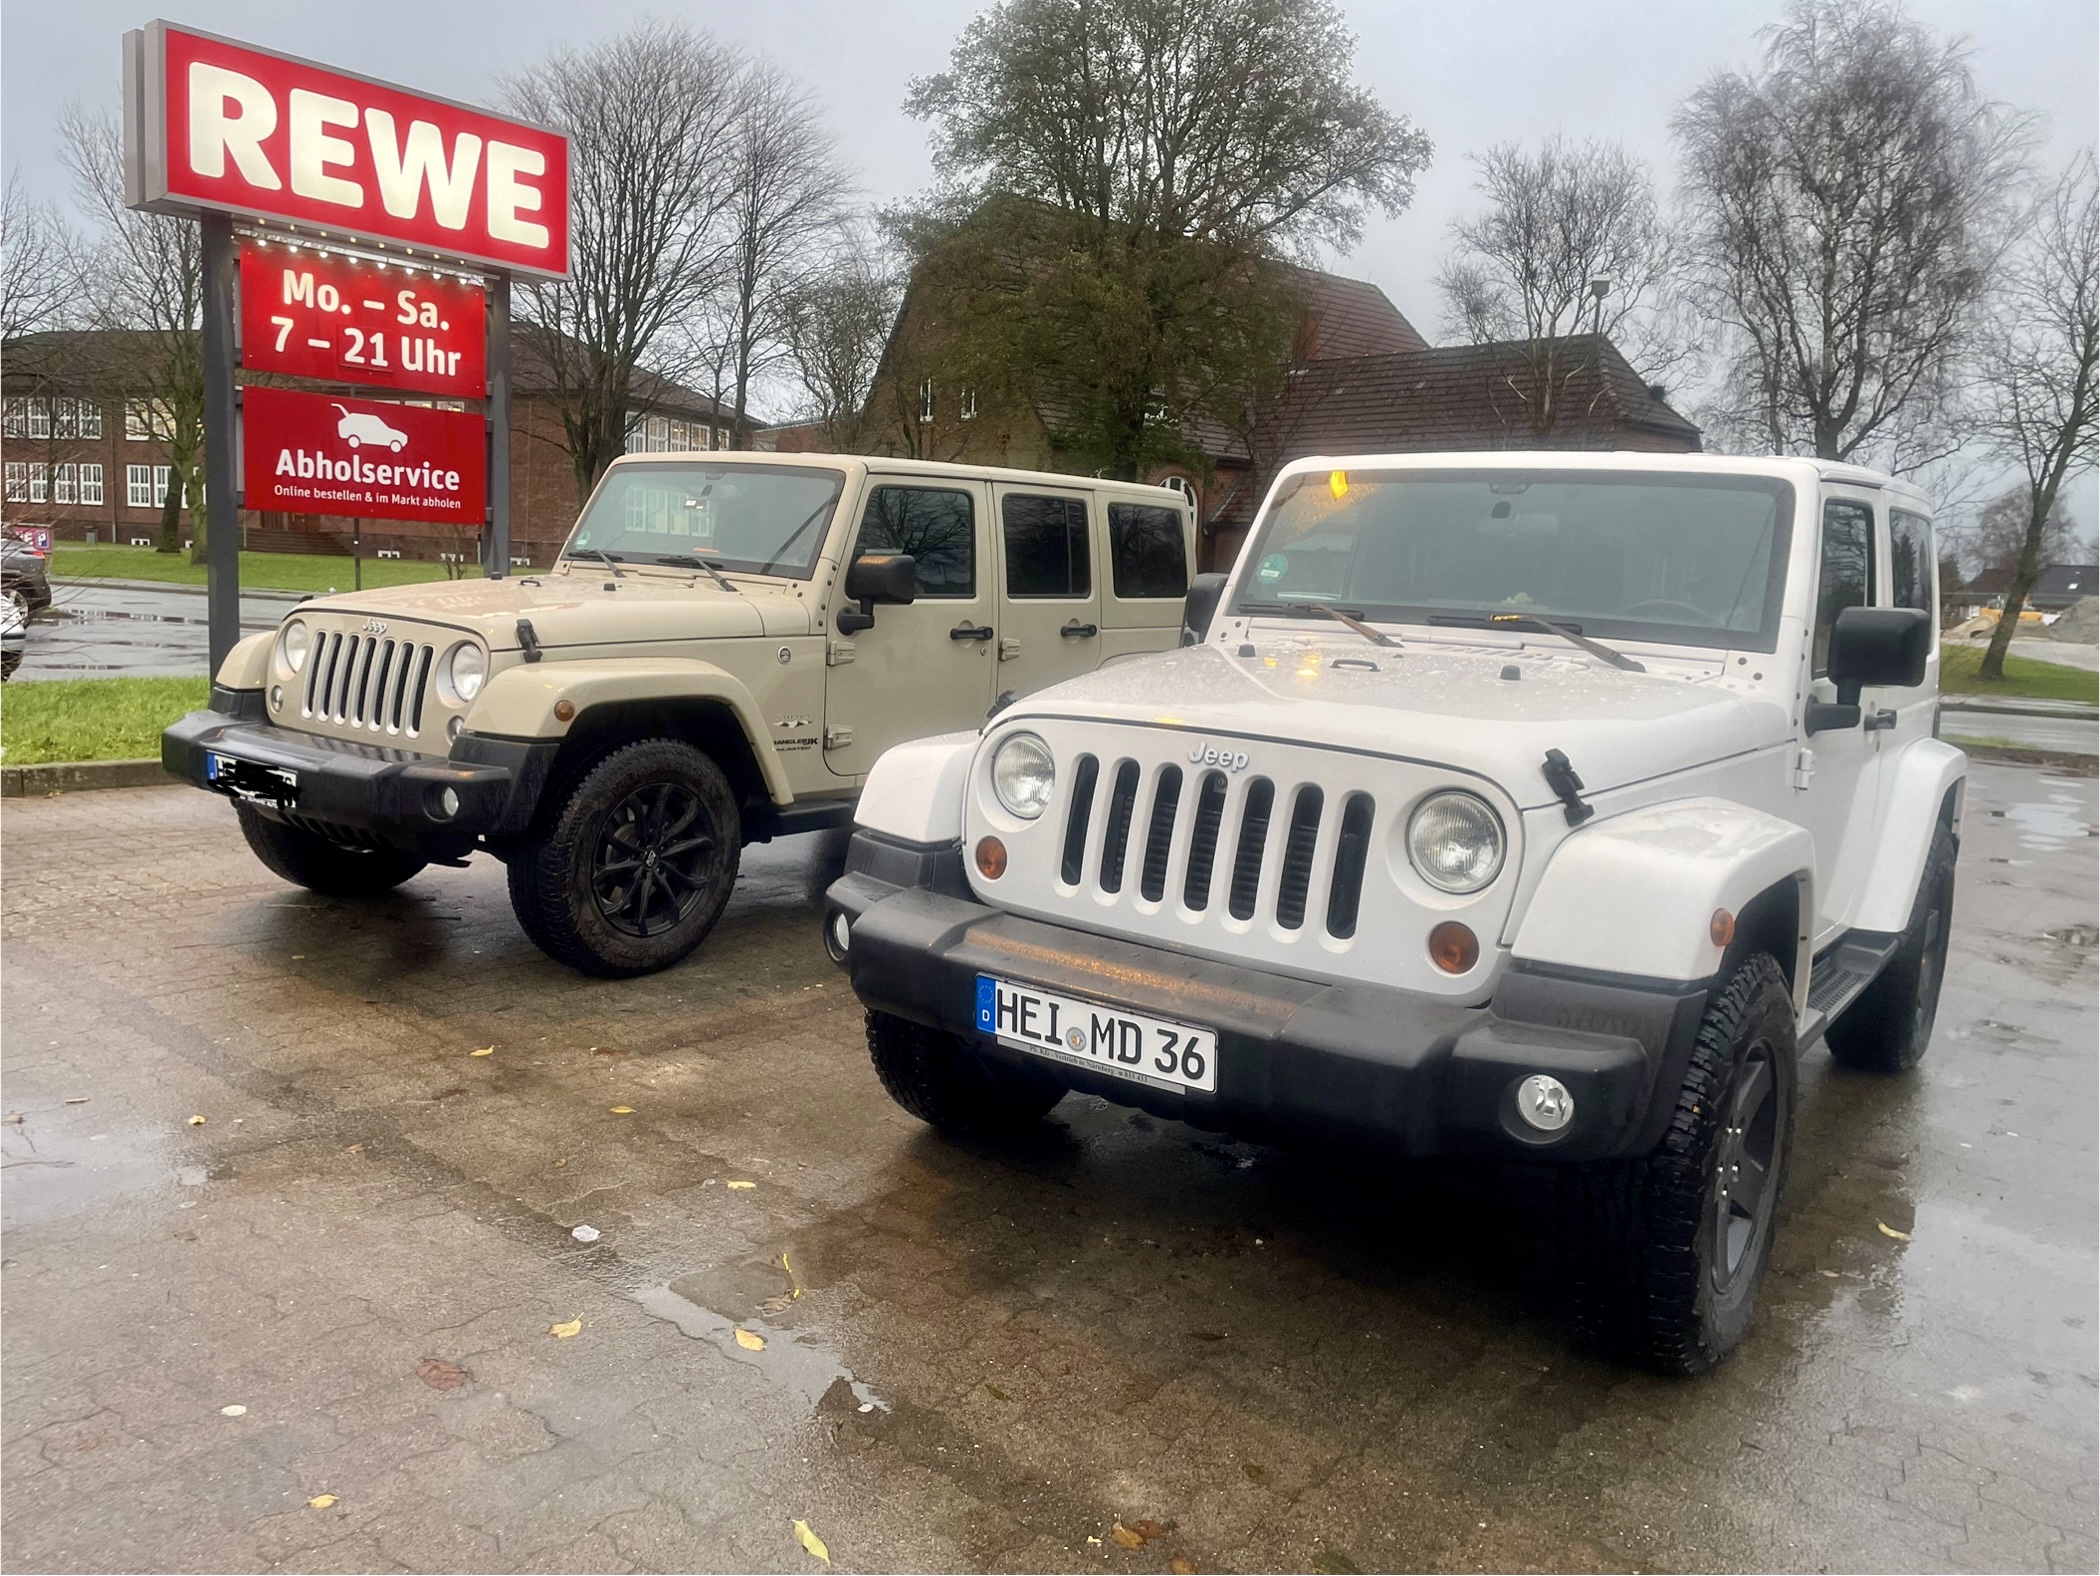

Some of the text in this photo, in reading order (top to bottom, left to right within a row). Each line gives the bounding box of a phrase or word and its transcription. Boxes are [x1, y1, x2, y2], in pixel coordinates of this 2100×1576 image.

[189, 61, 549, 249] REWE
[283, 269, 351, 315] Mo.
[397, 290, 449, 331] Sa.
[271, 315, 294, 352] 7
[343, 327, 389, 367] 21
[401, 335, 461, 376] Uhr
[275, 449, 460, 491] Abholservice
[274, 484, 461, 509] Online bestellen & im Markt abholen
[362, 617, 387, 636] Jeep
[1188, 742, 1249, 773] Jeep
[982, 1009, 990, 1021] D
[997, 988, 1205, 1080] HEI MD 36
